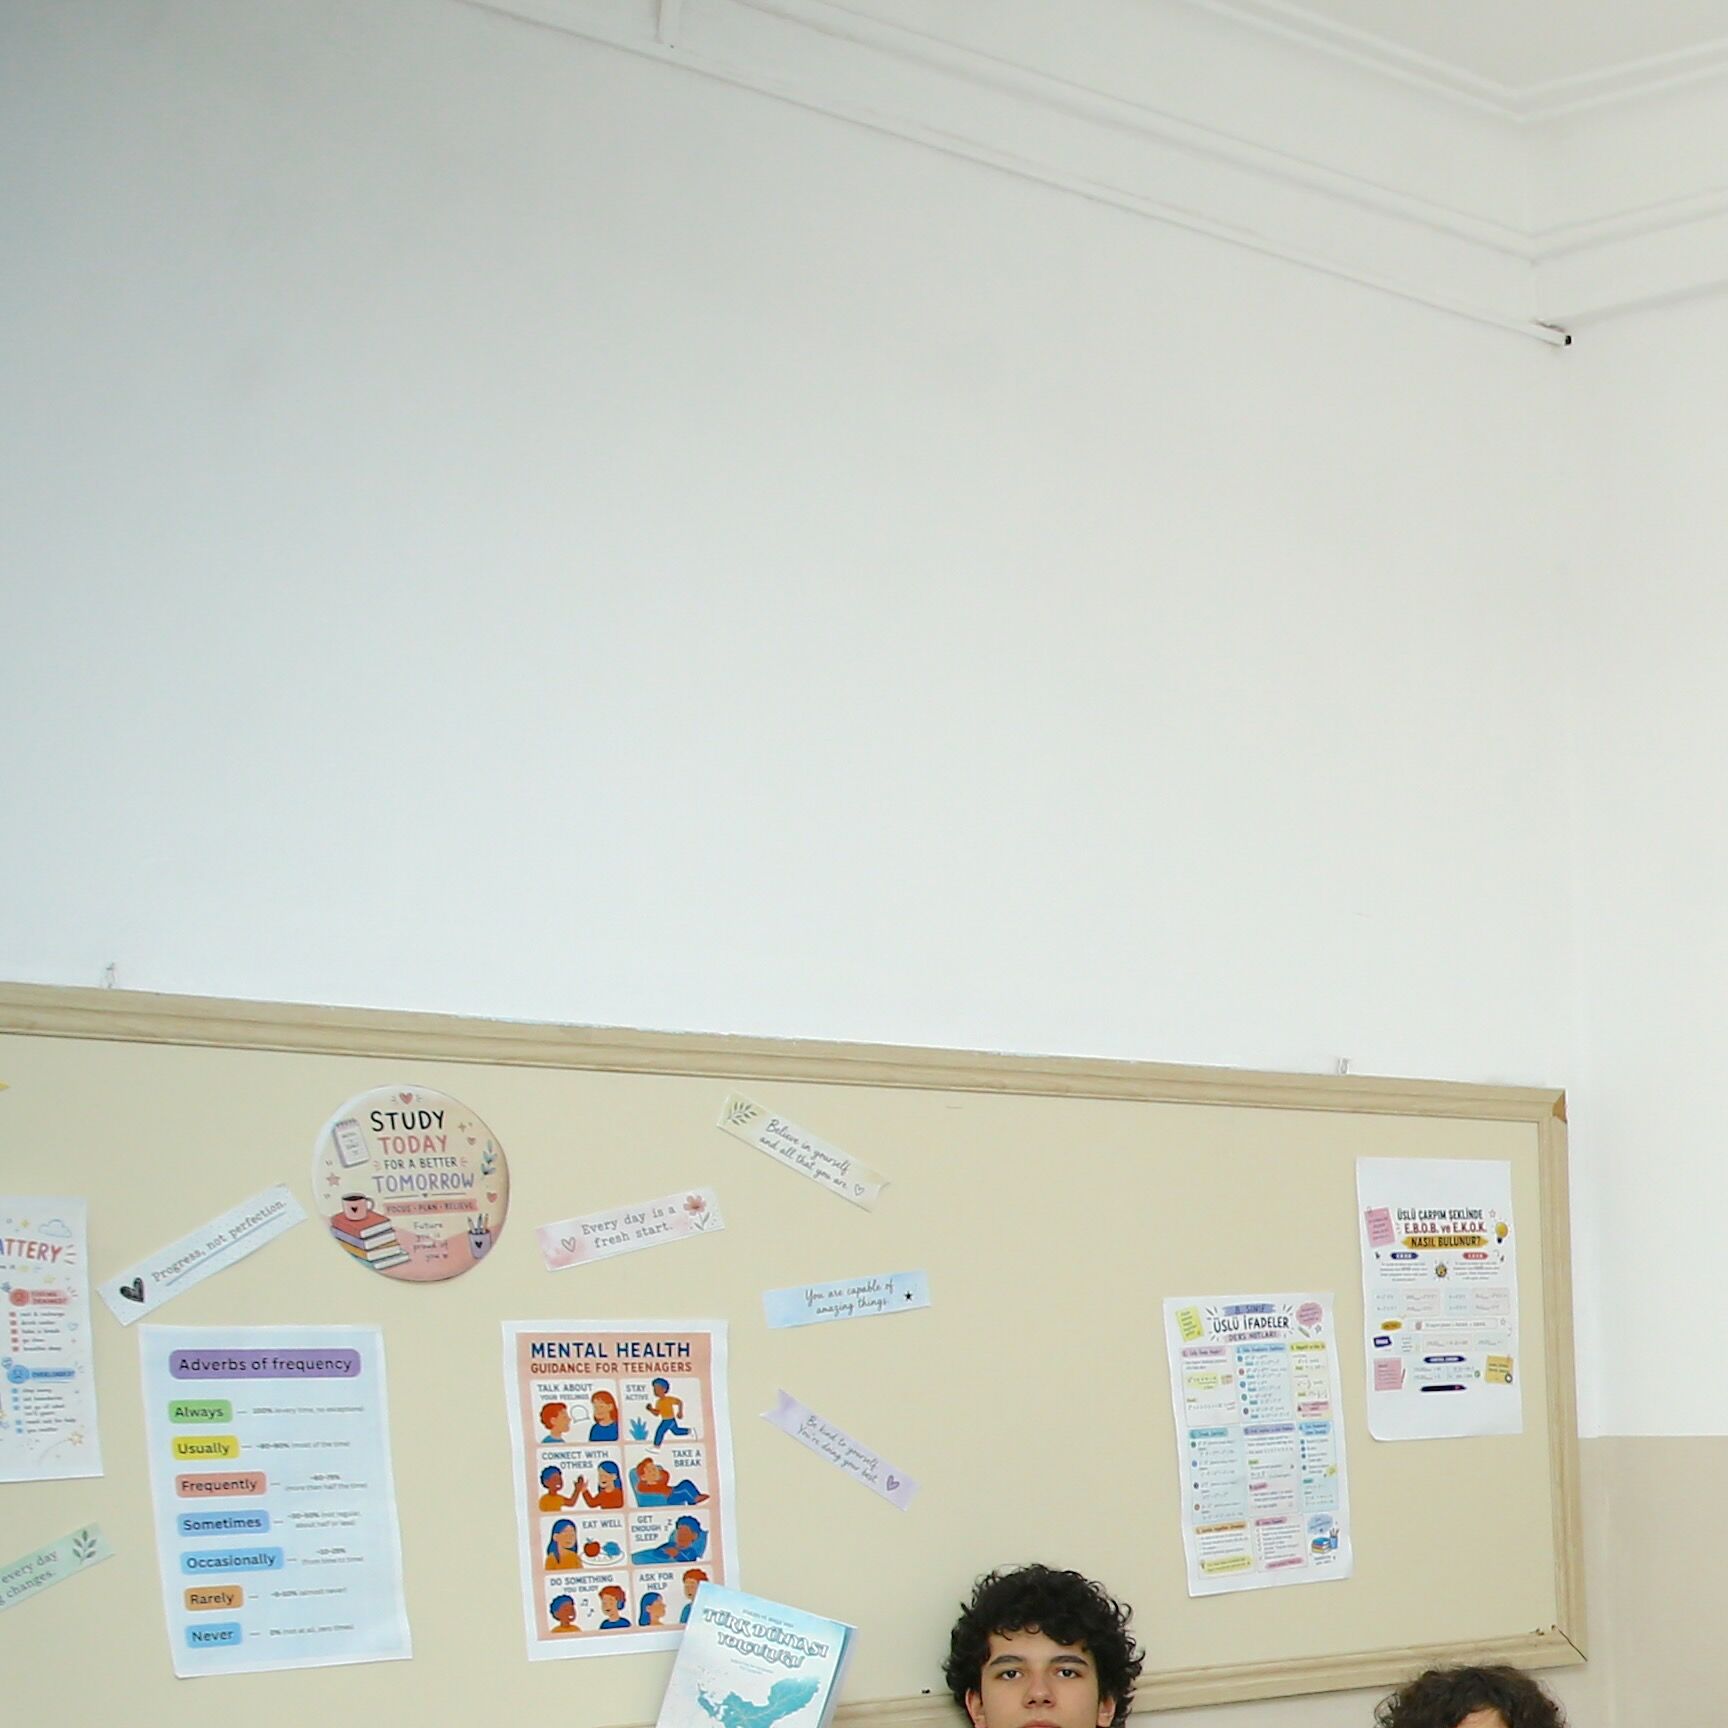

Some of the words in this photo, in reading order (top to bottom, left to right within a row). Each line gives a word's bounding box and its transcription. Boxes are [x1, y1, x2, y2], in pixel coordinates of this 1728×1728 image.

[370, 1110, 445, 1132] STUDY
[766, 1119, 799, 1145] Believe
[801, 1142, 811, 1151] in
[377, 1135, 448, 1155] TODAY
[384, 1158, 404, 1170] FOR
[408, 1158, 416, 1168] A
[419, 1156, 458, 1168] BETTER
[760, 1136, 777, 1149] and
[779, 1147, 796, 1159] all
[796, 1154, 815, 1170] that
[813, 1168, 831, 1181] you
[372, 1172, 475, 1194] TOMORROW
[582, 1219, 618, 1235] Every
[624, 1212, 646, 1226] day
[652, 1208, 663, 1218] is
[669, 1206, 676, 1214] a
[1397, 1208, 1417, 1221] ÜSLÜ
[1418, 1209, 1446, 1222] ÇARPIM
[1441, 1224, 1450, 1233] ve
[152, 1249, 206, 1282] Progress,
[206, 1234, 227, 1251] not
[229, 1200, 287, 1240] perfection.
[594, 1231, 630, 1249] fresh
[636, 1222, 673, 1238] start.
[1411, 1236, 1436, 1248] NASIL
[1438, 1236, 1481, 1247] BULUNUR?
[805, 1289, 824, 1307] You
[828, 1289, 843, 1298] are
[847, 1280, 880, 1297] capable
[882, 1279, 894, 1294] of
[816, 1303, 855, 1317] amazing
[1213, 1317, 1240, 1333] ÜSLÜ
[1243, 1314, 1290, 1331] İFADELER
[531, 1342, 608, 1359] MENTAL
[617, 1342, 690, 1358] HEALTH
[179, 1358, 246, 1371] Adverbs
[251, 1358, 268, 1370] of
[272, 1357, 352, 1373] frequency
[531, 1363, 591, 1374] GUIDANCE
[596, 1363, 618, 1373] FOR
[623, 1362, 692, 1373] TEENAGERS
[537, 1384, 561, 1393] TALK
[563, 1384, 593, 1392] ABOUT
[626, 1385, 646, 1393] STAY
[175, 1407, 224, 1420] Always
[806, 1416, 817, 1427] Be
[178, 1443, 230, 1456] Usually
[542, 1451, 581, 1461] CONNECT
[585, 1451, 609, 1459] WITH
[672, 1450, 693, 1458] TAKE
[821, 1442, 841, 1462] doing
[841, 1459, 859, 1471] your
[560, 1461, 594, 1470] OTHERS
[674, 1459, 701, 1468] BREAK
[182, 1479, 258, 1492] Frequently
[183, 1518, 262, 1531] Sometimes
[582, 1521, 598, 1529] EAT
[600, 1520, 623, 1529] WELL
[637, 1515, 653, 1523] GET
[631, 1524, 662, 1533] ENOUGH
[635, 1533, 659, 1542] SLEEP
[1, 1563, 33, 1584] every
[36, 1551, 57, 1566] day
[187, 1554, 276, 1569] Occasionally
[550, 1578, 562, 1587] DO
[564, 1574, 614, 1586] SOMETHING
[639, 1573, 656, 1582] ASK
[658, 1572, 674, 1581] FOR
[563, 1586, 577, 1594] YOU
[646, 1582, 668, 1591] HELP
[190, 1593, 234, 1606] Rarely
[192, 1629, 234, 1642] Never
[703, 1608, 751, 1637] TÜRK
[752, 1624, 830, 1658] DÜNYASI
[717, 1632, 805, 1668] YOLCULUĞU
